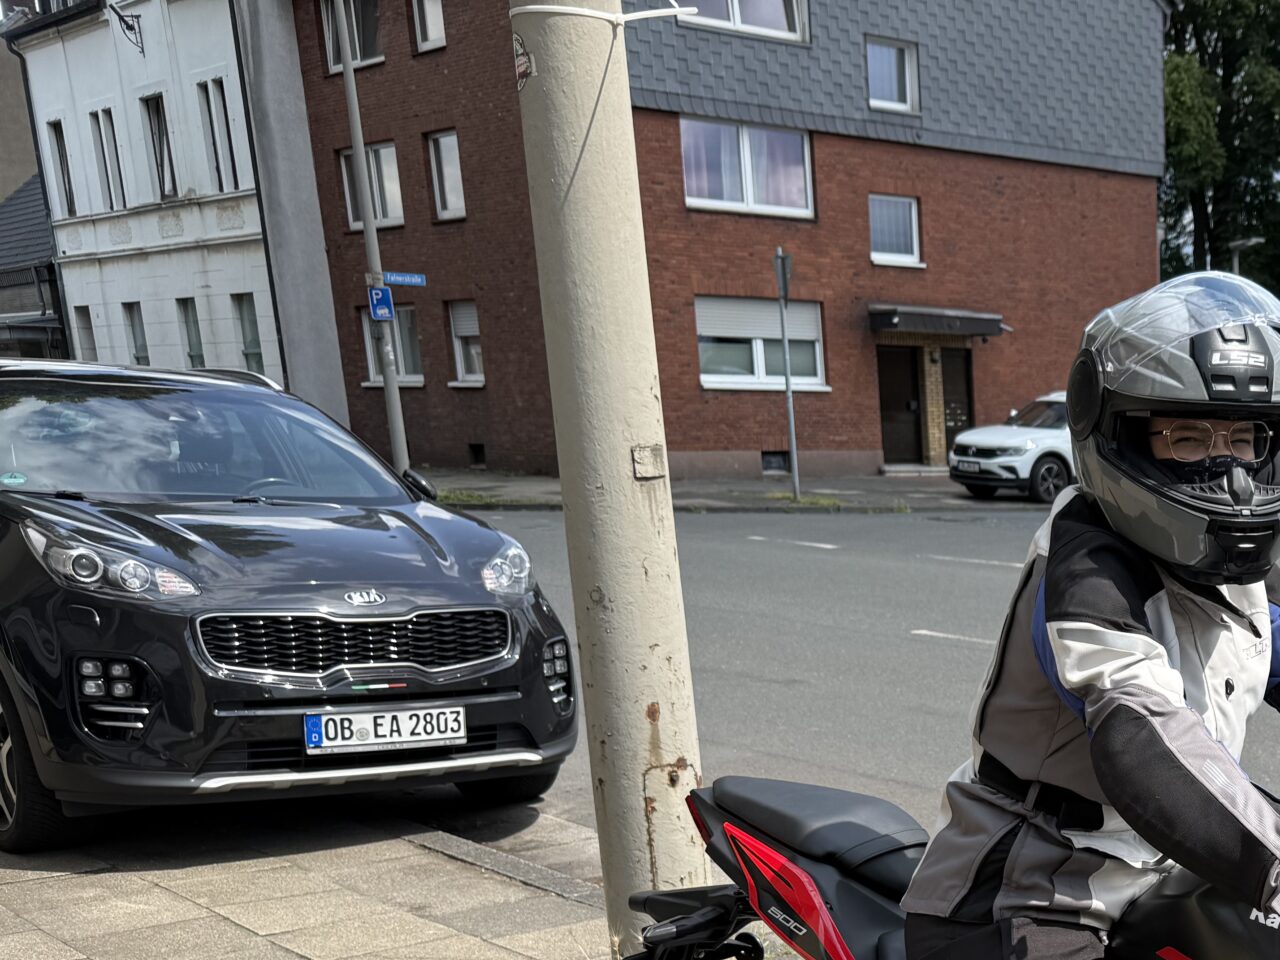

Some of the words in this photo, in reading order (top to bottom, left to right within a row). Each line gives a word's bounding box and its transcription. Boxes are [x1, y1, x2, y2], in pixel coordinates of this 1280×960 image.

[372, 290, 383, 305] P
[1211, 350, 1265, 368] LS2
[324, 717, 355, 742] OB
[372, 714, 403, 739] EA
[408, 710, 462, 737] 2803
[767, 905, 808, 936] 500
